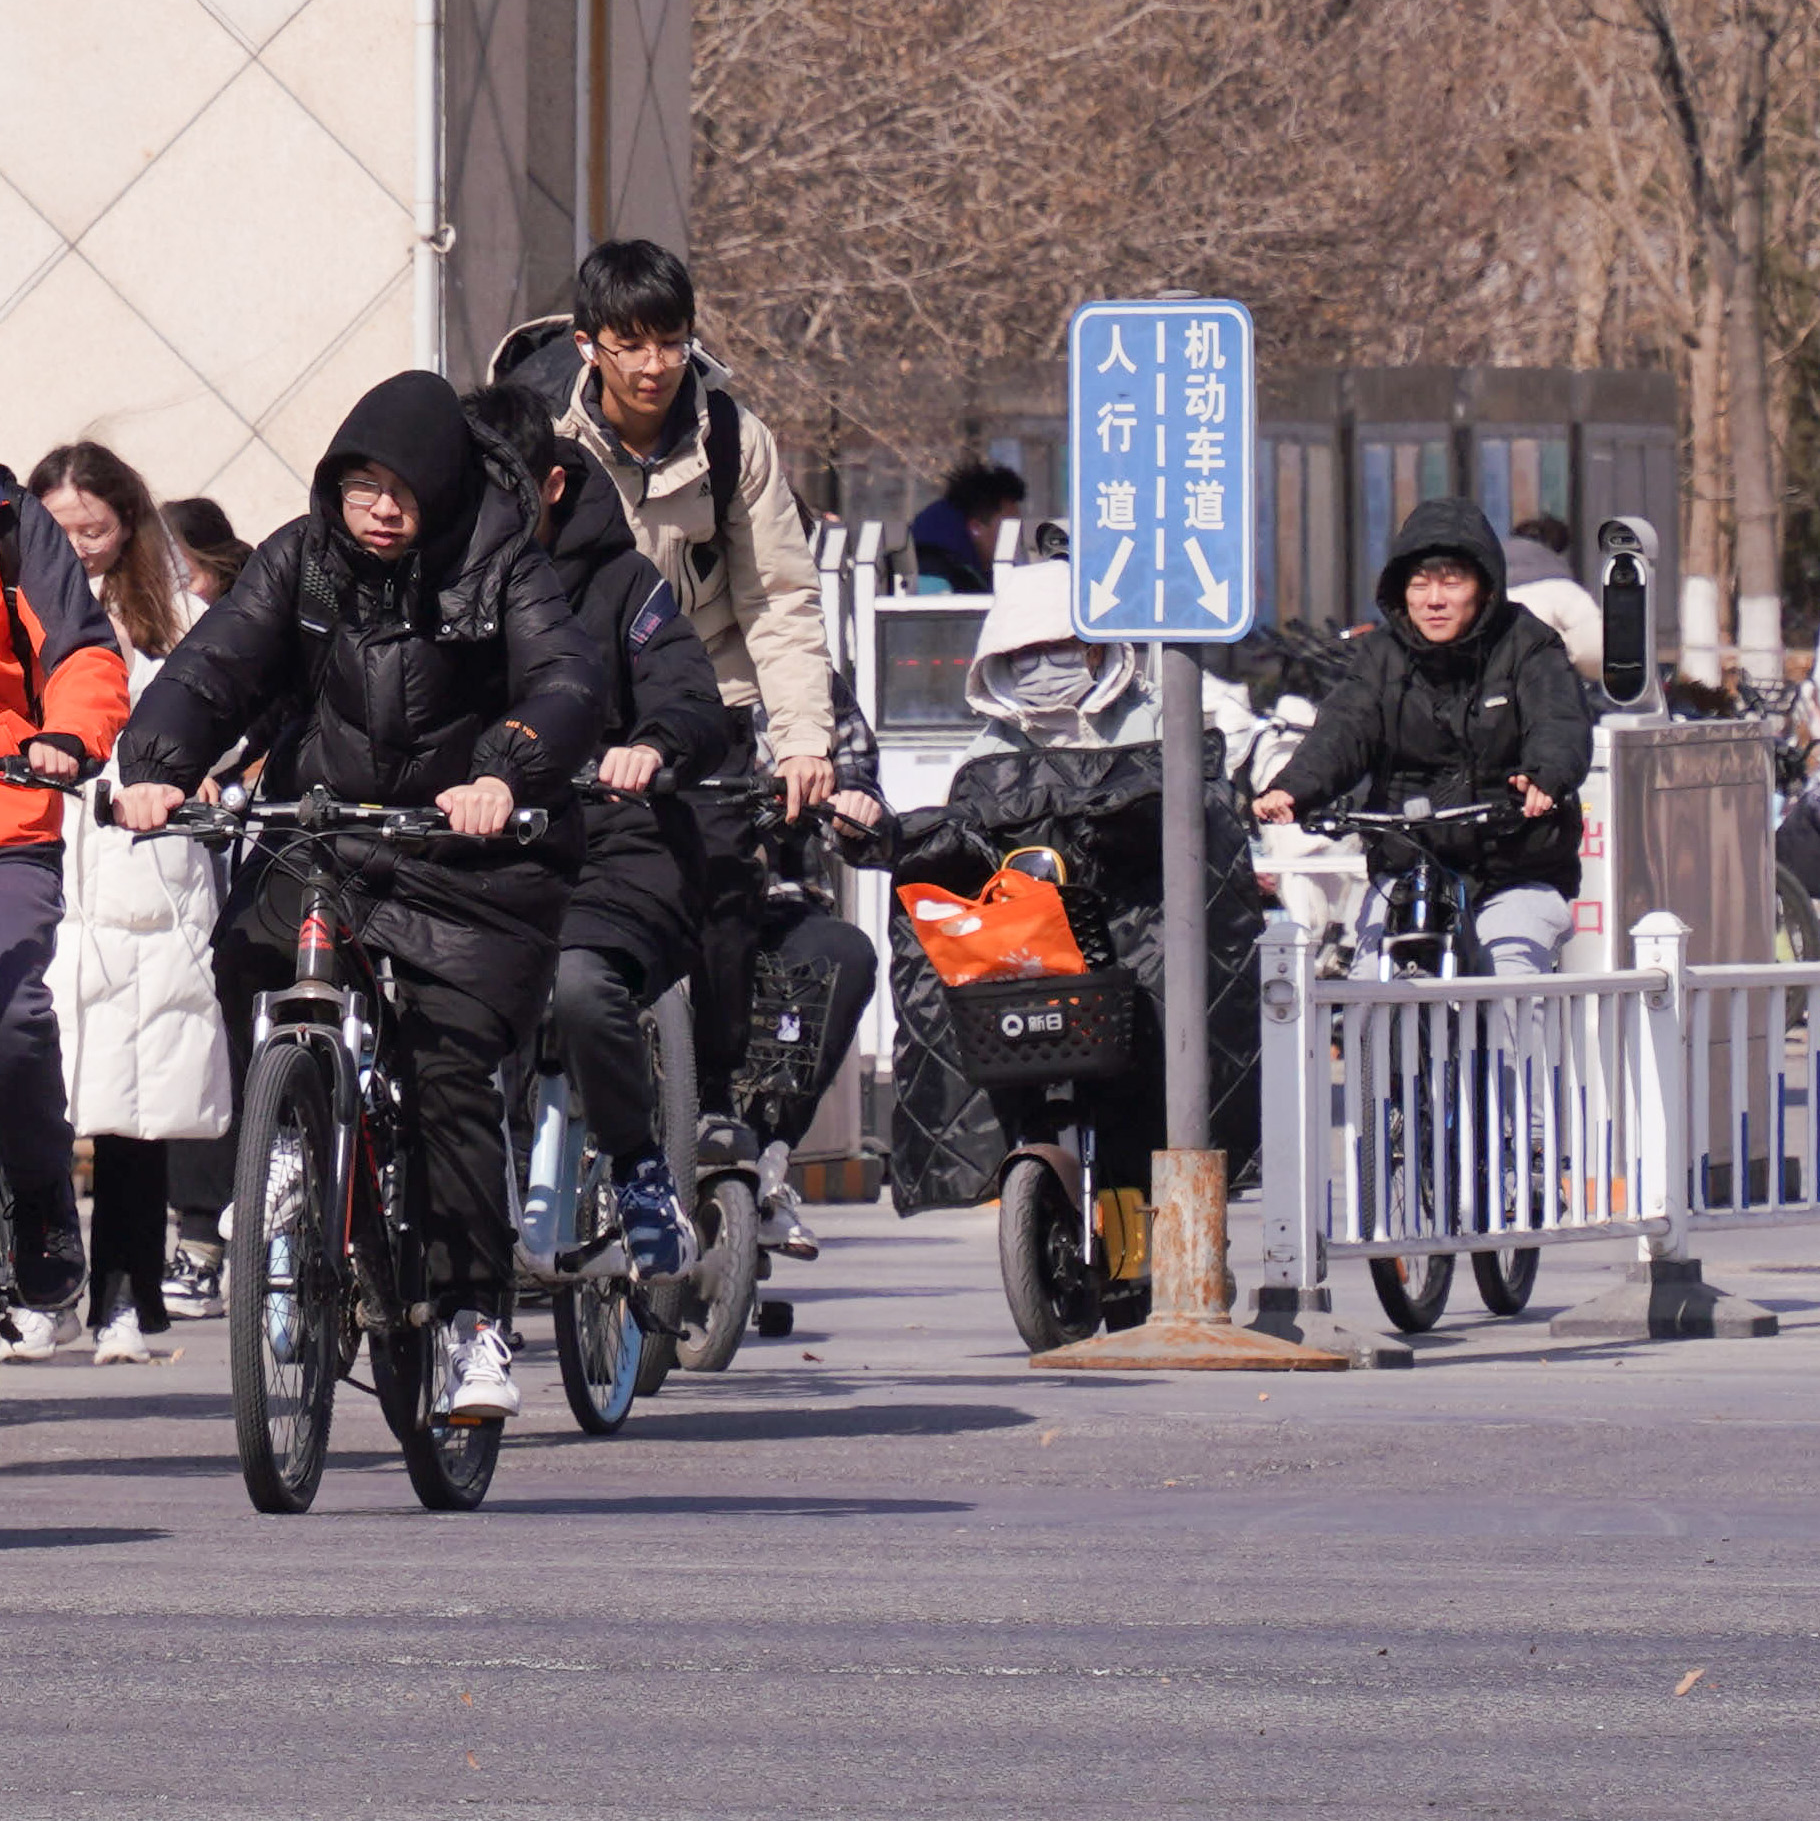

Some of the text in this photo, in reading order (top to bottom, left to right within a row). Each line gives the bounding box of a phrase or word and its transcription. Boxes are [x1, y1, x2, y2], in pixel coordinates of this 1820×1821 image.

[1096, 324, 1138, 531] 人行道
[1183, 319, 1227, 531] 机动车道
[1027, 1012, 1063, 1033] 新日
